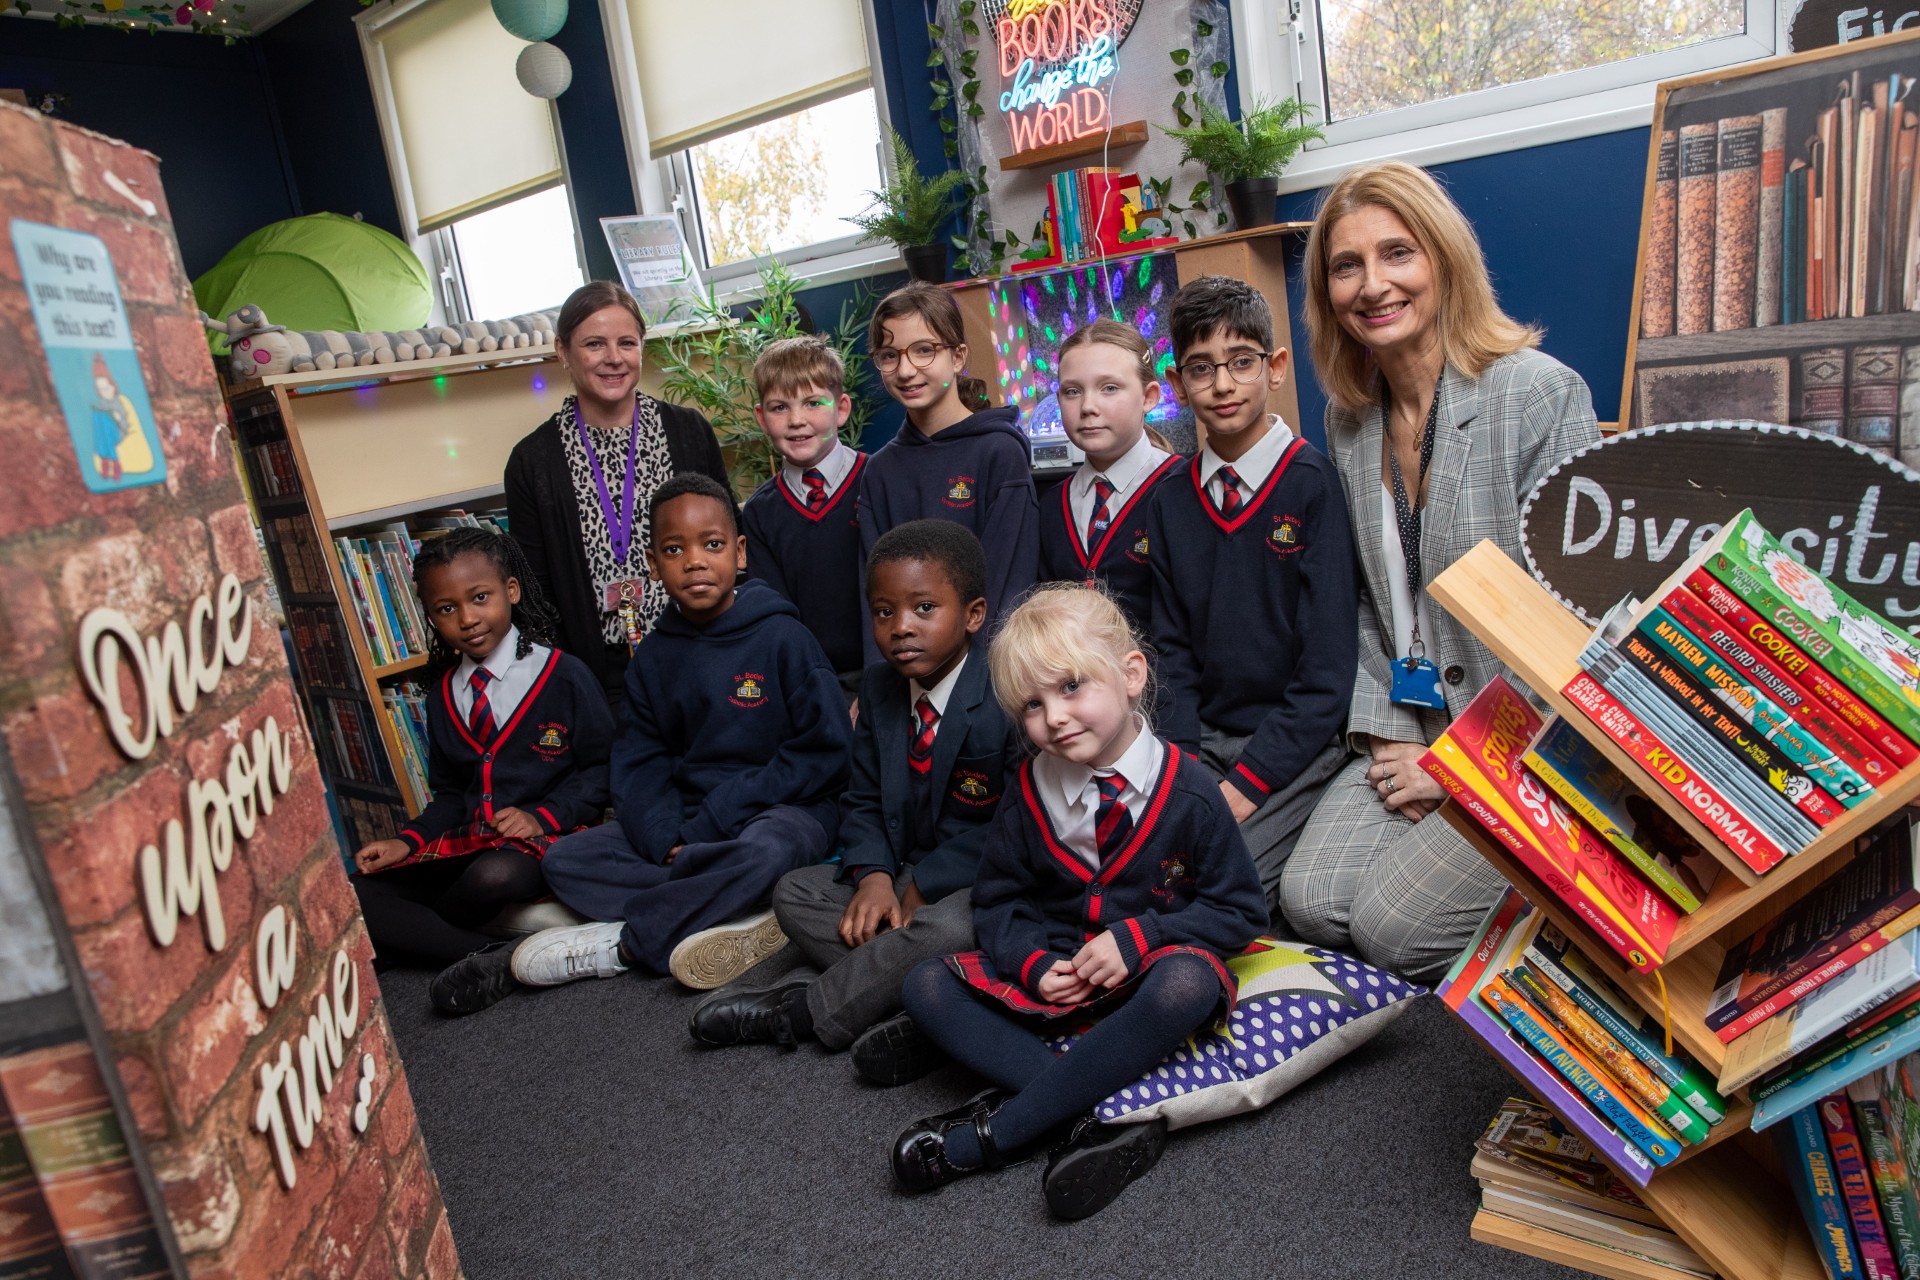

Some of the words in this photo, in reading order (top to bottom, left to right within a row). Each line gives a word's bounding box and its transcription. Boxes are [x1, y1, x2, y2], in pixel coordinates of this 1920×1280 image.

[1000, 0, 1112, 77] BOOKS
[1000, 58, 1073, 111] change
[1066, 35, 1115, 87] the
[1010, 88, 1106, 153] WORLD
[35, 240, 72, 275] Why
[73, 252, 98, 272] are
[35, 283, 62, 306] you
[64, 284, 117, 312] reading
[52, 312, 83, 337] this
[84, 318, 118, 338] text?
[1562, 476, 1920, 618] Divesity
[1730, 564, 1764, 594] KONNIE
[1730, 575, 1752, 597] HUQ
[1707, 582, 1742, 614] KONNIE
[1707, 595, 1729, 616] HUQ
[1770, 602, 1835, 661] COOKIE!
[1746, 619, 1810, 677] COOKIE!
[79, 573, 252, 759] Once
[1654, 619, 1707, 668] MAYHEM
[1704, 662, 1757, 711] MISSION
[1708, 627, 1756, 670] RECORD
[1749, 661, 1802, 709] SMASHERS
[1566, 682, 1598, 713] JAMES
[1576, 675, 1606, 705] GREG
[1626, 637, 1655, 665] THERE'S
[1649, 658, 1662, 672] A
[1657, 664, 1696, 700] WEREWOLF
[1689, 693, 1705, 708] IN
[1699, 701, 1718, 721] MY
[1713, 713, 1741, 740] TENT!
[1599, 702, 1608, 712] &
[1607, 704, 1636, 732] CHRIS
[1830, 687, 1849, 704] MOST
[1847, 701, 1879, 730] ANNOYING
[1838, 705, 1862, 727] WORLD
[1482, 697, 1528, 781] STORIES
[1598, 711, 1628, 740] SMITH
[1751, 743, 1771, 761] PAMELA
[1757, 708, 1804, 750] BURHANA
[1805, 749, 1837, 778] ISLAM
[1427, 761, 1463, 795] STORIES
[1468, 798, 1498, 827] SOUTH
[1492, 822, 1523, 852] ASIAN
[1531, 757, 1542, 768] A
[1538, 764, 1560, 785] Girl
[1557, 781, 1587, 810] Called
[1584, 806, 1606, 827] Dog
[1644, 744, 1689, 788] KID
[1679, 777, 1761, 854] NORMAL
[141, 715, 291, 951] upon
[1627, 846, 1649, 867] Nicola
[1647, 864, 1670, 886] Davies
[1482, 923, 1503, 949] Culture
[255, 905, 297, 1009] a
[1475, 946, 1490, 962] Our
[1530, 950, 1545, 965] The
[1541, 960, 1571, 989] Knowledge
[1785, 965, 1809, 982] TANYA
[1789, 977, 1818, 998] TROUBLE
[1751, 978, 1786, 1002] LANDMAN
[1556, 1005, 1582, 1030] Dream
[1764, 1002, 1776, 1013] PIP
[1514, 1019, 1537, 1041] PICKLE
[1574, 991, 1595, 1011] MORE
[1594, 1009, 1635, 1048] MURDEROUS
[1634, 1045, 1659, 1069] MATHS
[1535, 1034, 1558, 1057] ART
[1551, 1049, 1599, 1096] AVENGER
[1775, 1046, 1799, 1064] DAVIES
[1621, 1065, 1649, 1092] Theresa
[1759, 1077, 1792, 1099] WAYLAND
[1601, 1098, 1626, 1123] Olaf
[1638, 1096, 1652, 1109] TOM
[1651, 1107, 1677, 1132] PALMER
[1864, 1107, 1878, 1132] Ewa
[1803, 1113, 1817, 1148] COPELAND
[1835, 1141, 1882, 1244] EVERDARK
[1884, 1178, 1898, 1196] The
[1884, 1194, 1904, 1229] Mystery
[1898, 1226, 1909, 1239] of
[1899, 1236, 1912, 1253] the
